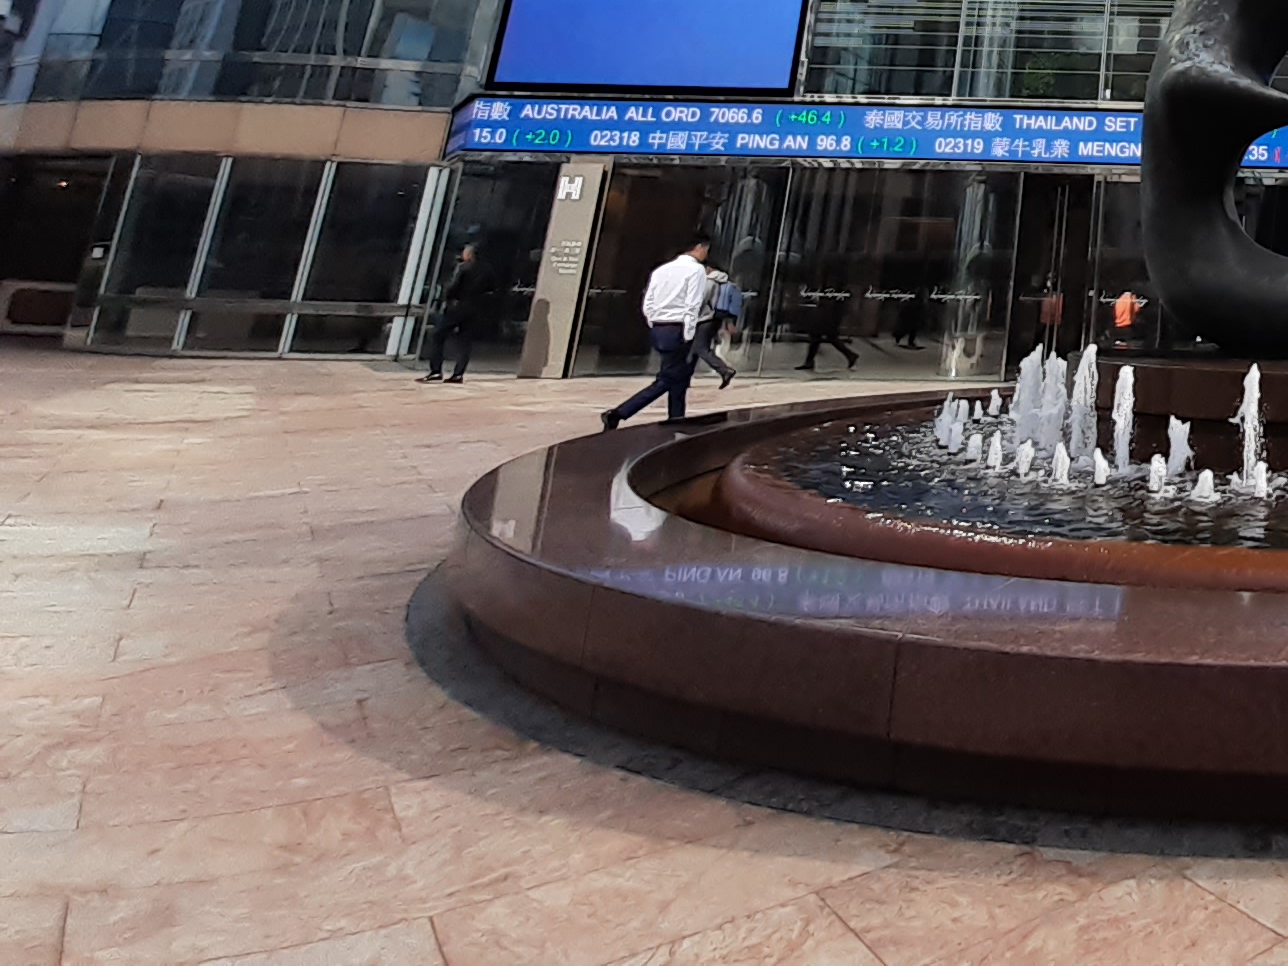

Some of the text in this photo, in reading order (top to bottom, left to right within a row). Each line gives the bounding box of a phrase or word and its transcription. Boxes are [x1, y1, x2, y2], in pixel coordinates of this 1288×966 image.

[472, 100, 511, 121] 指數
[520, 104, 617, 121] AUSTRALIA
[624, 105, 656, 122] ALL
[661, 106, 700, 122] ORD
[709, 107, 763, 124] 7066.6
[864, 109, 1003, 132] 泰國交易所指數
[1014, 114, 1097, 131] THAILAND
[1104, 117, 1138, 132] SET
[589, 130, 640, 147] 02318
[648, 131, 729, 151] 中國平安
[736, 134, 780, 150] PING
[783, 135, 808, 151] AN
[816, 136, 851, 151] 96.8
[935, 138, 983, 154] 02319
[990, 137, 1071, 158] 蒙牛乳業
